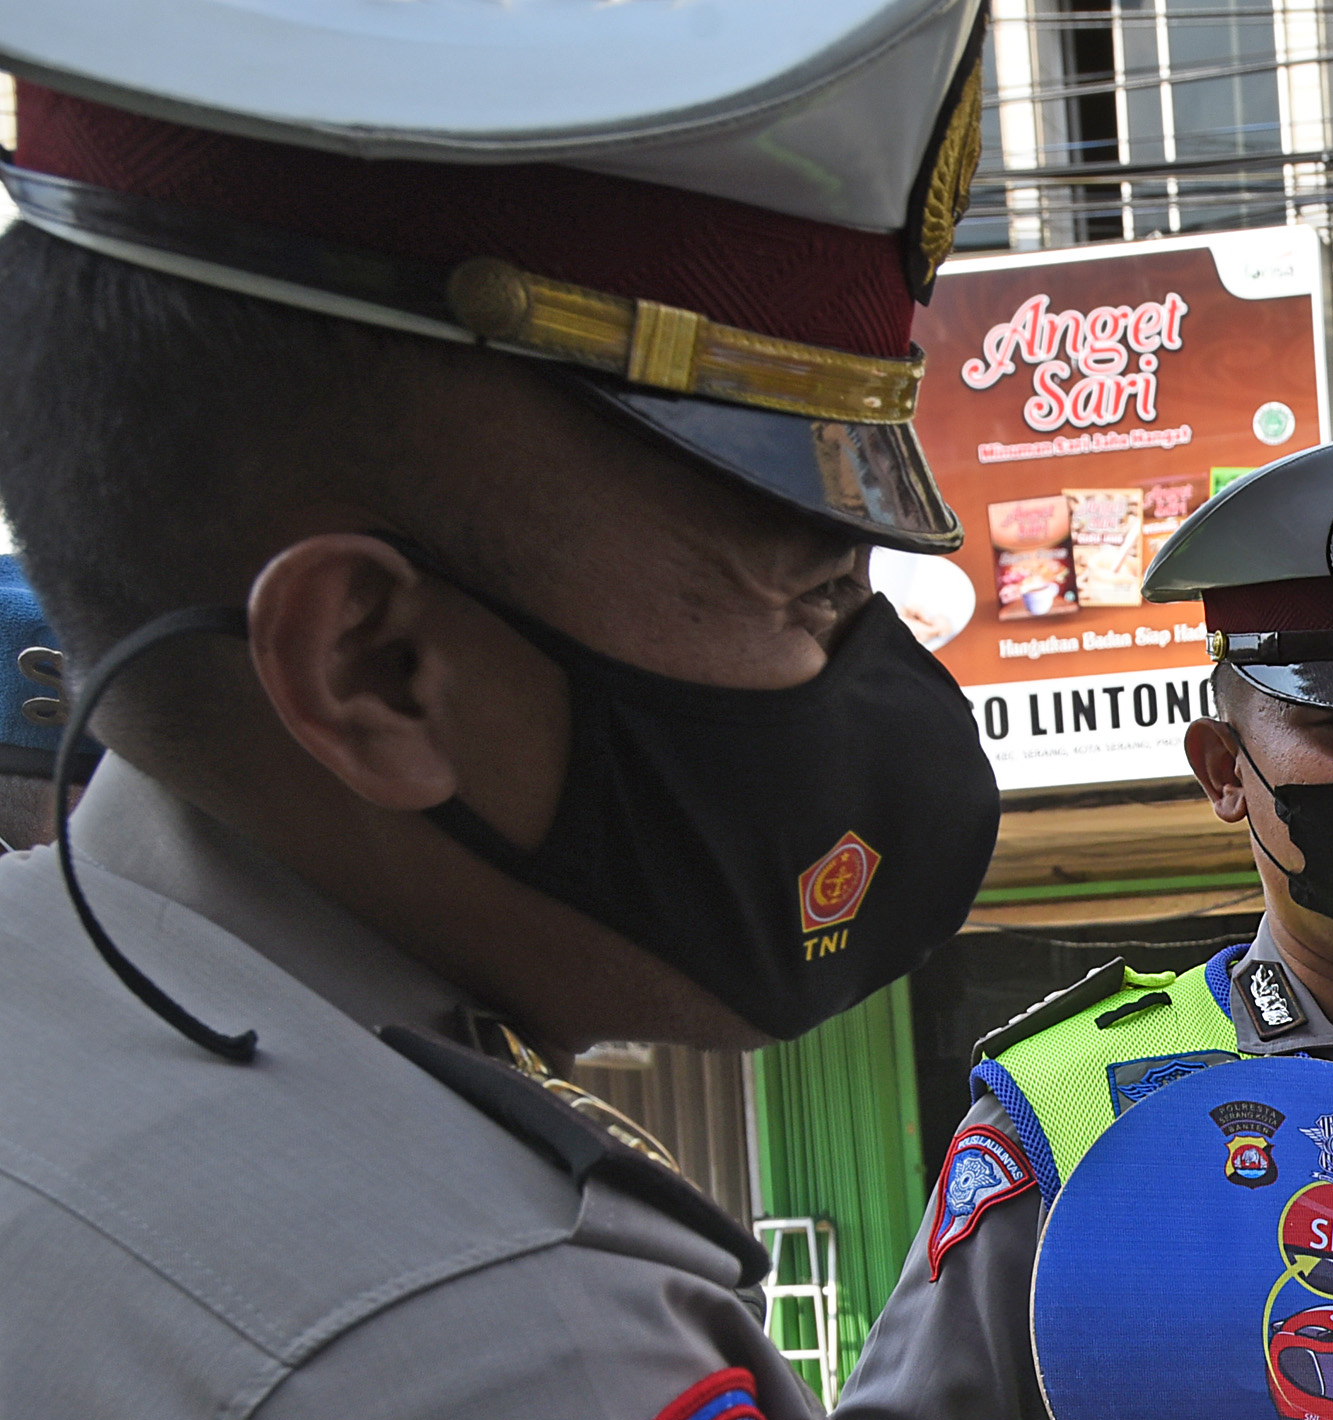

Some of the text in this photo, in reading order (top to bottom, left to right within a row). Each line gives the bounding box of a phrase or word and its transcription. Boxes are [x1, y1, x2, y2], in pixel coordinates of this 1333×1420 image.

[962, 292, 1189, 391] Anget
[1024, 352, 1158, 433] Sari
[999, 621, 1206, 659] Hangatkan Badan Siap Had
[803, 928, 849, 962] TNI
[1219, 1101, 1277, 1117] POLRESTA
[1228, 1123, 1270, 1135] BANTEN
